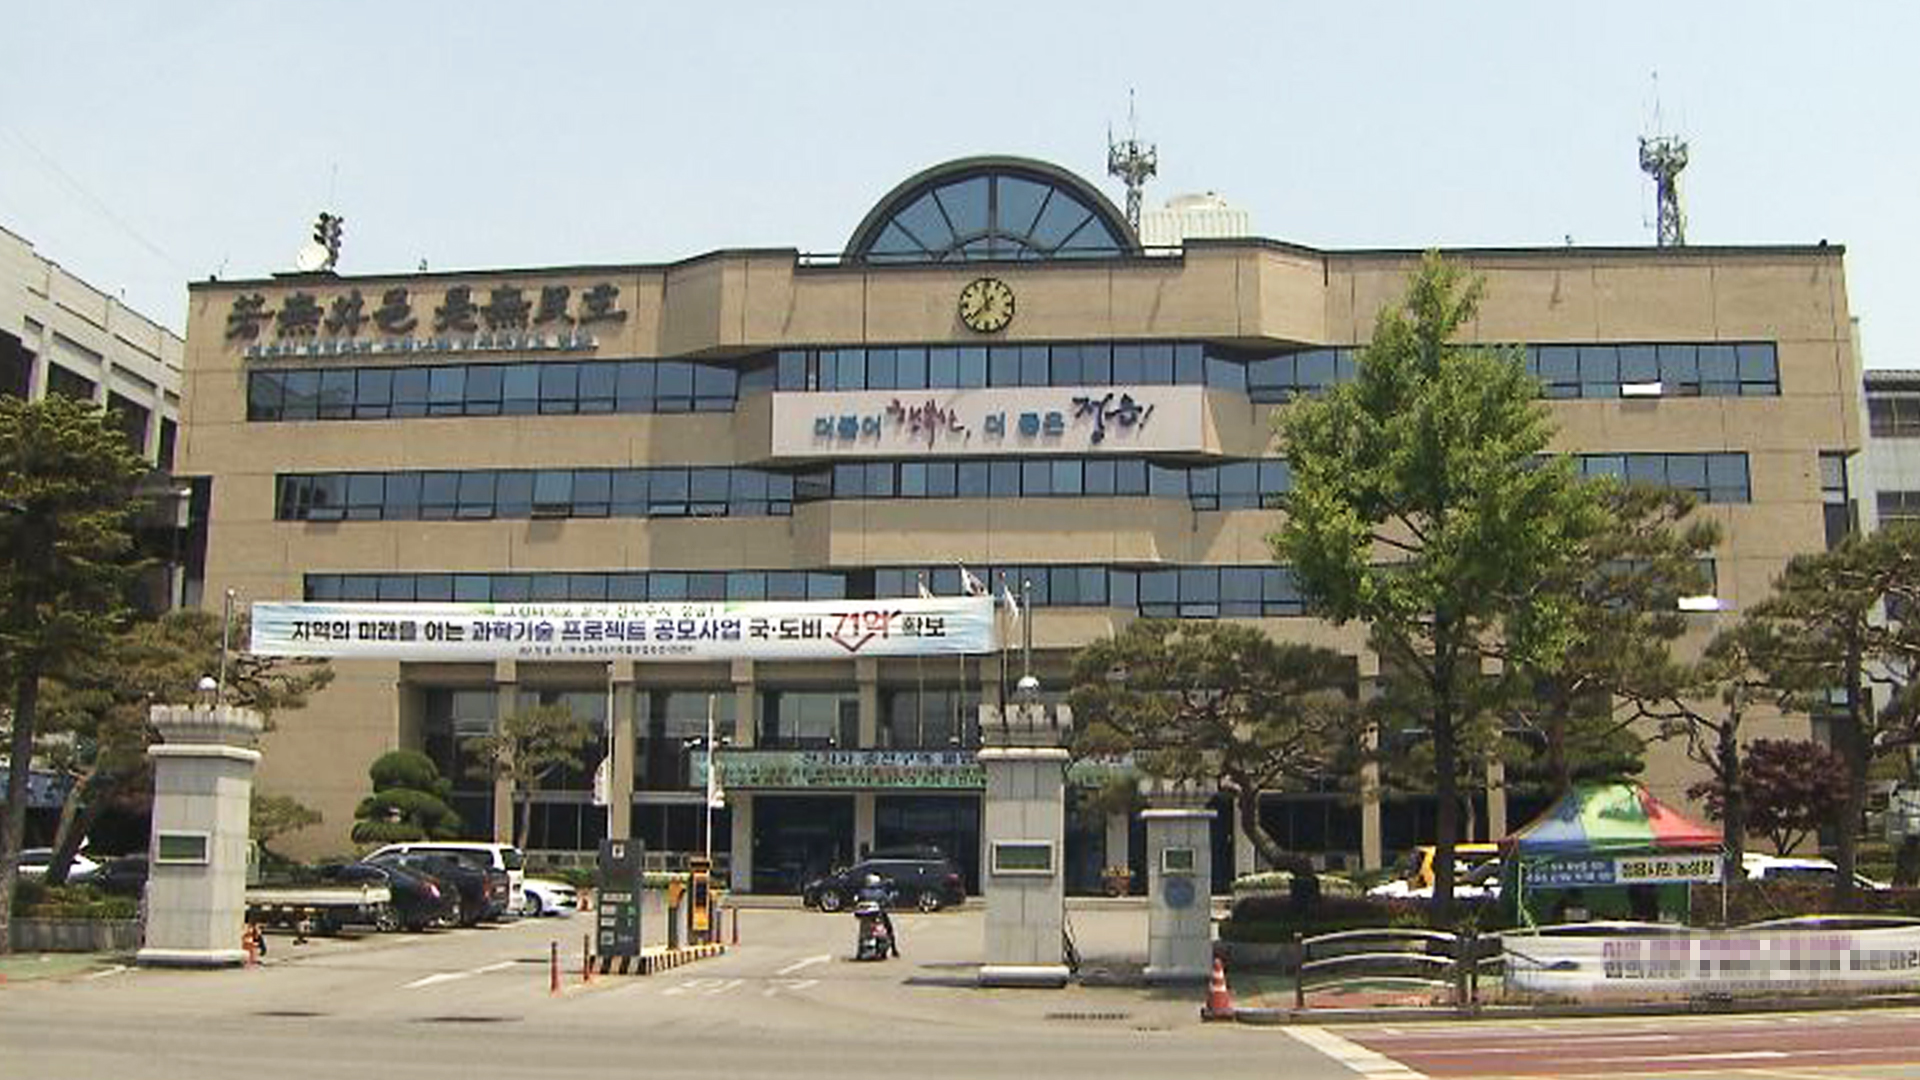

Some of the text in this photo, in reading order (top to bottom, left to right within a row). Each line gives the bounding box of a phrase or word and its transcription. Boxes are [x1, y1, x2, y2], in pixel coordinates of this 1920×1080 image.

[814, 411, 881, 441] 더불어
[984, 411, 1006, 438] 더
[1018, 411, 1065, 439] 좋은
[1071, 392, 1155, 445] 정읍!
[291, 619, 351, 641] 지역의
[357, 620, 419, 642] 미래를
[472, 619, 555, 642] 과학기술
[561, 619, 647, 642] 프로젝트
[653, 618, 742, 642] 공모사업
[901, 616, 946, 638] 확보
